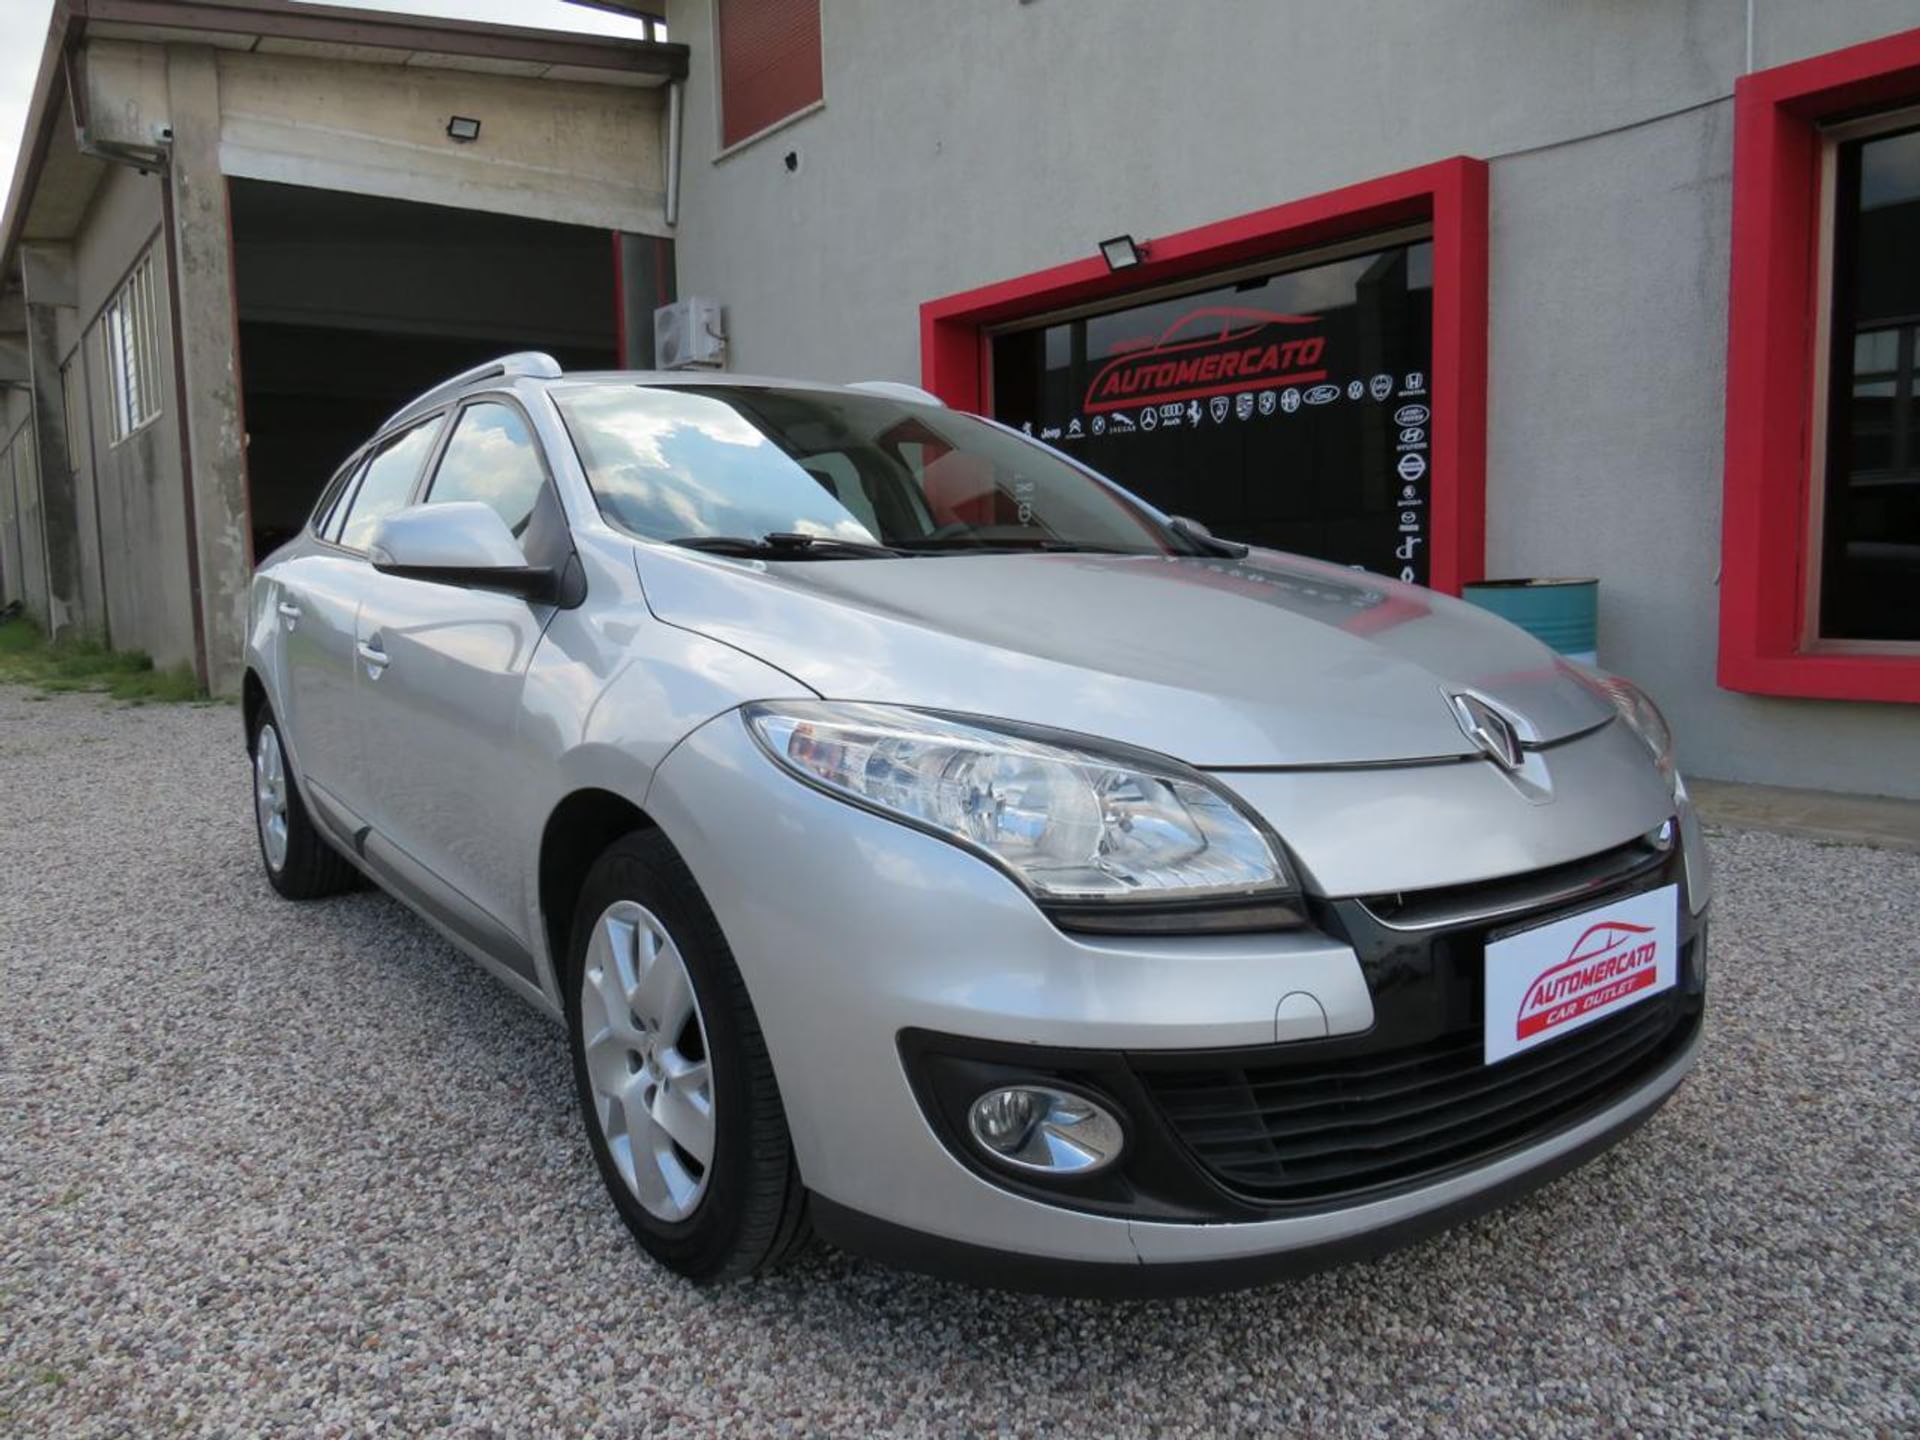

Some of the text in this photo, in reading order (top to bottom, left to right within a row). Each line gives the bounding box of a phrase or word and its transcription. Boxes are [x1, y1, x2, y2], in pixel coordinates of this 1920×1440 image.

[1101, 337, 1326, 397] AUTOMERCATO
[1530, 941, 1657, 1010] AUTOMERCATO
[1546, 977, 1637, 1025] CAR OUTLET
